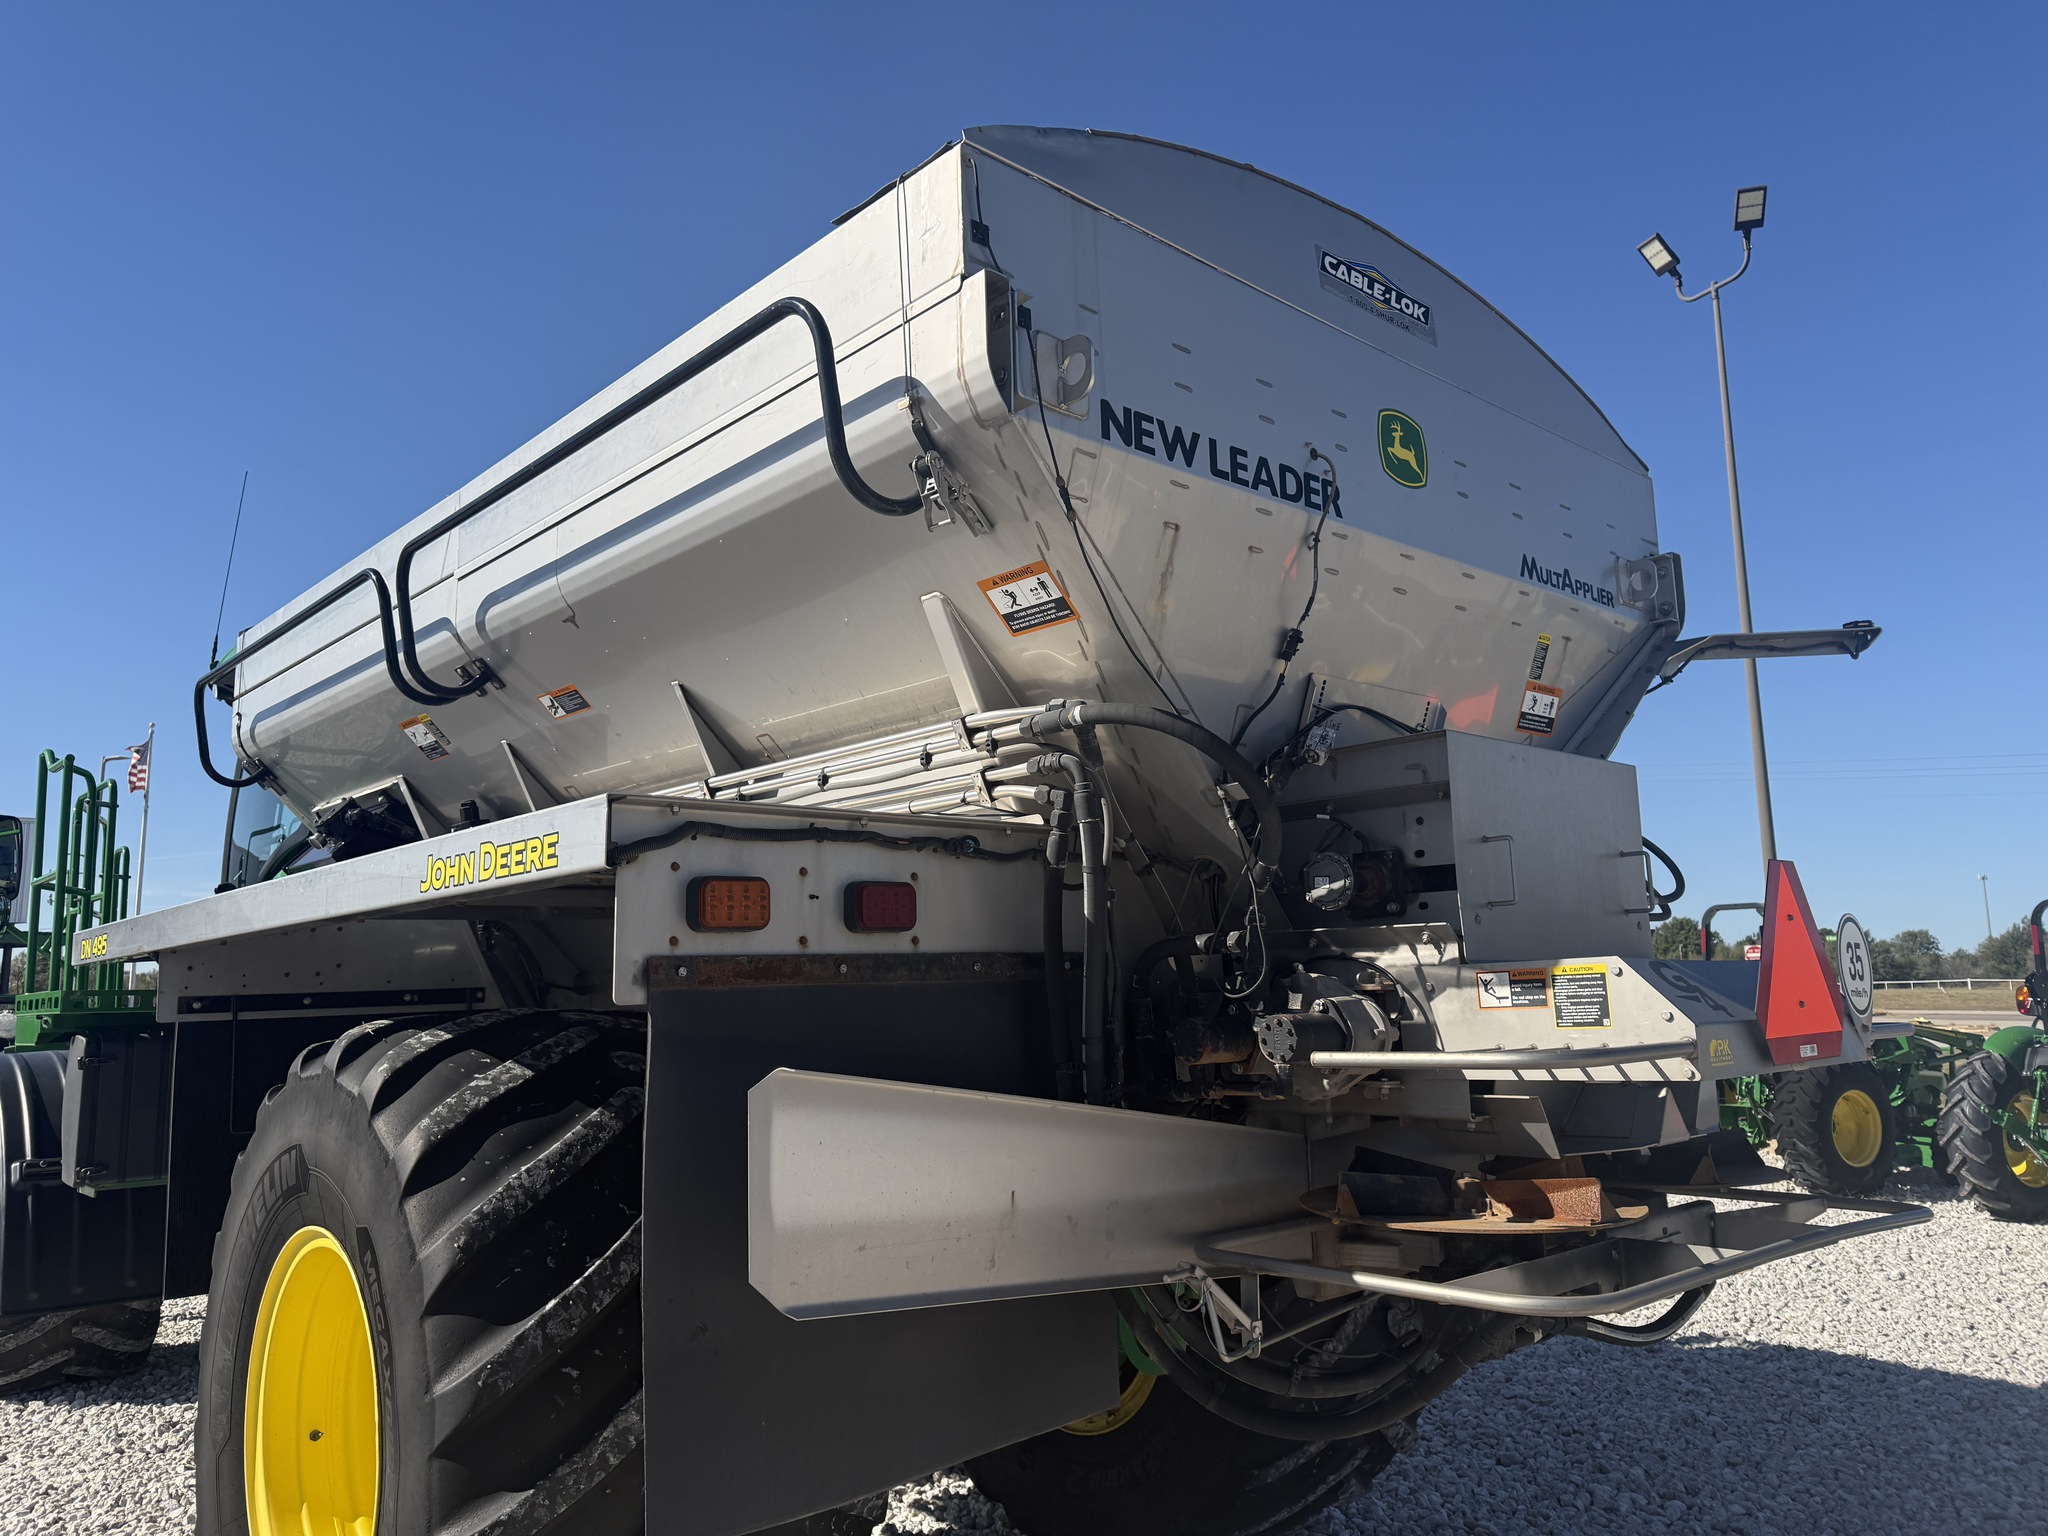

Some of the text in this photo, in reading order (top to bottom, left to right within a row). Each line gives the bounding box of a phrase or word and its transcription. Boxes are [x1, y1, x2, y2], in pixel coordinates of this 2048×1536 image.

[1100, 398, 1344, 519] NEW LEADER
[998, 566, 1034, 583] WARNING
[1537, 685, 1556, 695] WARNING
[420, 831, 559, 893] JOHN DEERE
[81, 933, 108, 960] DN 495
[1846, 941, 1865, 982] 35
[1517, 970, 1544, 978] WARNING
[1850, 987, 1869, 998] mile/h
